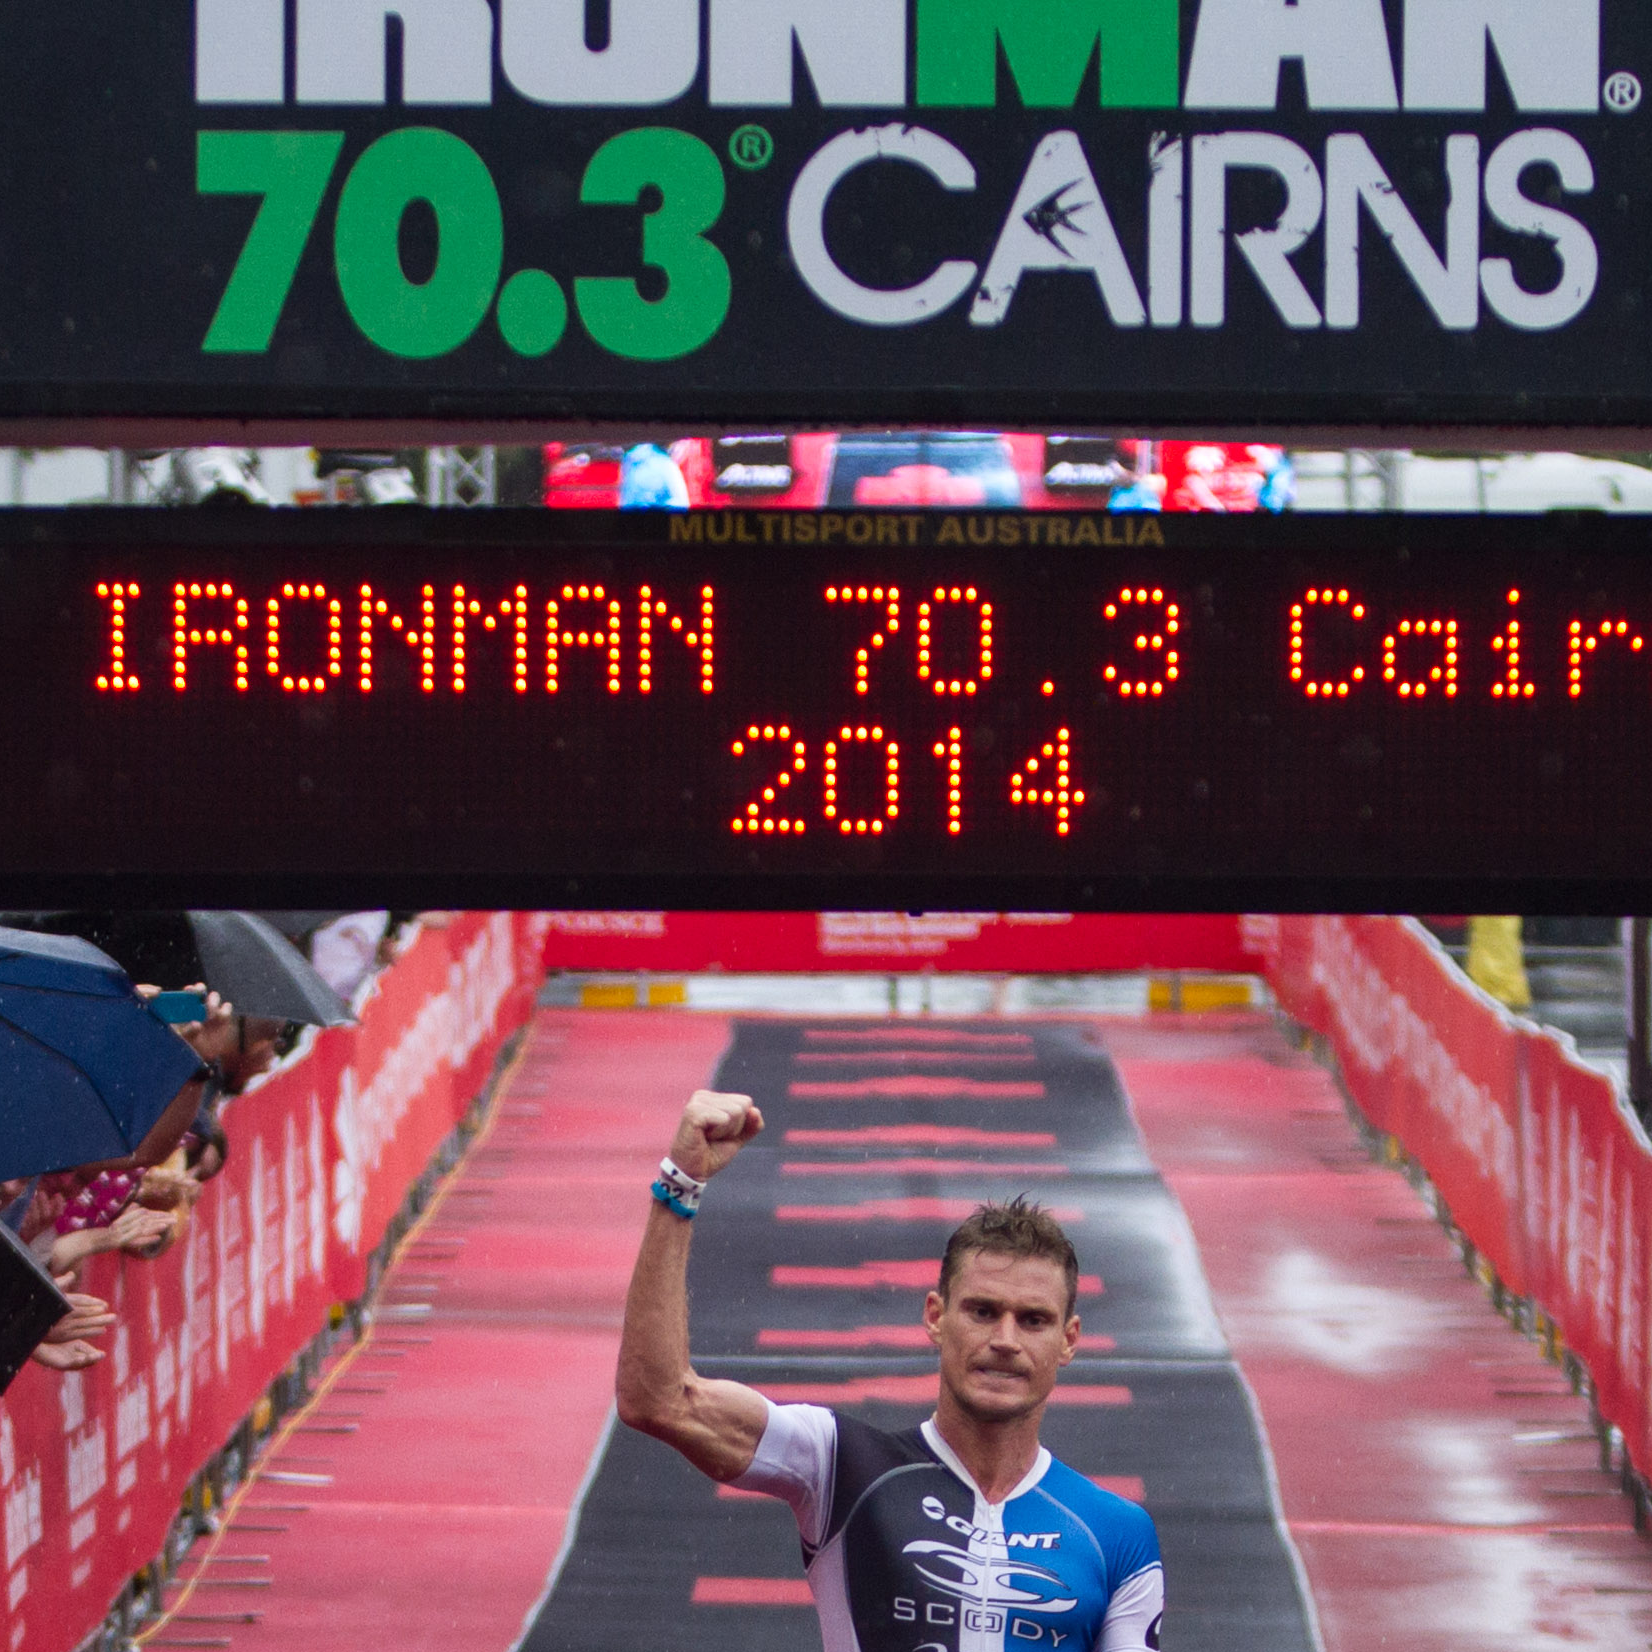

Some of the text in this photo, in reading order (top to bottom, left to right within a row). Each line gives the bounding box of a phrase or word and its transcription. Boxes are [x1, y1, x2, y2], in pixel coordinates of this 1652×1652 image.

[195, 124, 1599, 360] 70.3 CAIRNS
[670, 515, 1164, 547] MULTISPORT AUSTRALIA
[94, 580, 715, 695] IRONMAN
[823, 584, 1181, 698] 70.3
[730, 723, 1086, 837] 2014
[946, 1515, 1062, 1550] GIANT
[893, 1596, 1068, 1648] SCODY
